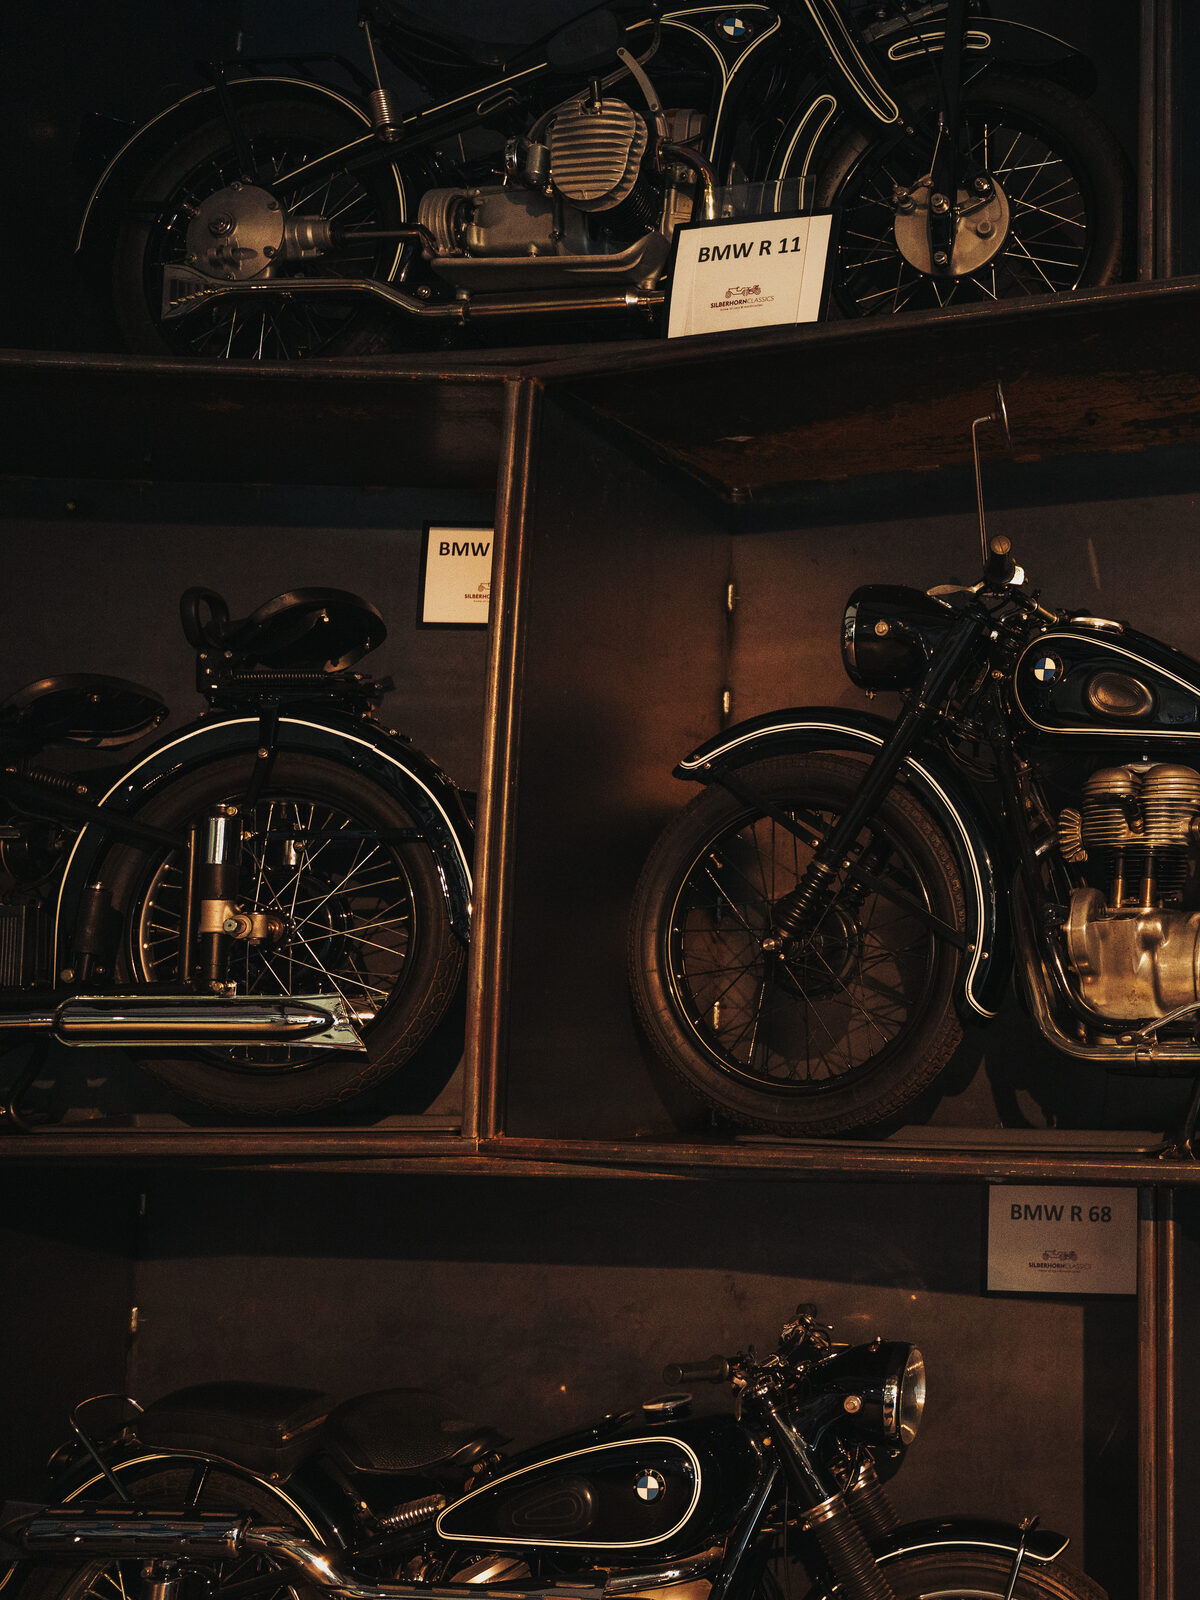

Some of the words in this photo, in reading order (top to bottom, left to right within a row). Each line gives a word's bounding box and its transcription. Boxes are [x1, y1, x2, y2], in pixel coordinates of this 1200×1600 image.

[698, 242, 754, 263] BMW
[759, 240, 772, 256] R
[778, 236, 801, 254] 11
[710, 295, 774, 309] SILBERHORNCLASSICS
[439, 542, 490, 557] BMW
[1011, 1204, 1064, 1221] BMW
[1071, 1206, 1082, 1221] R
[1089, 1206, 1112, 1222] 68
